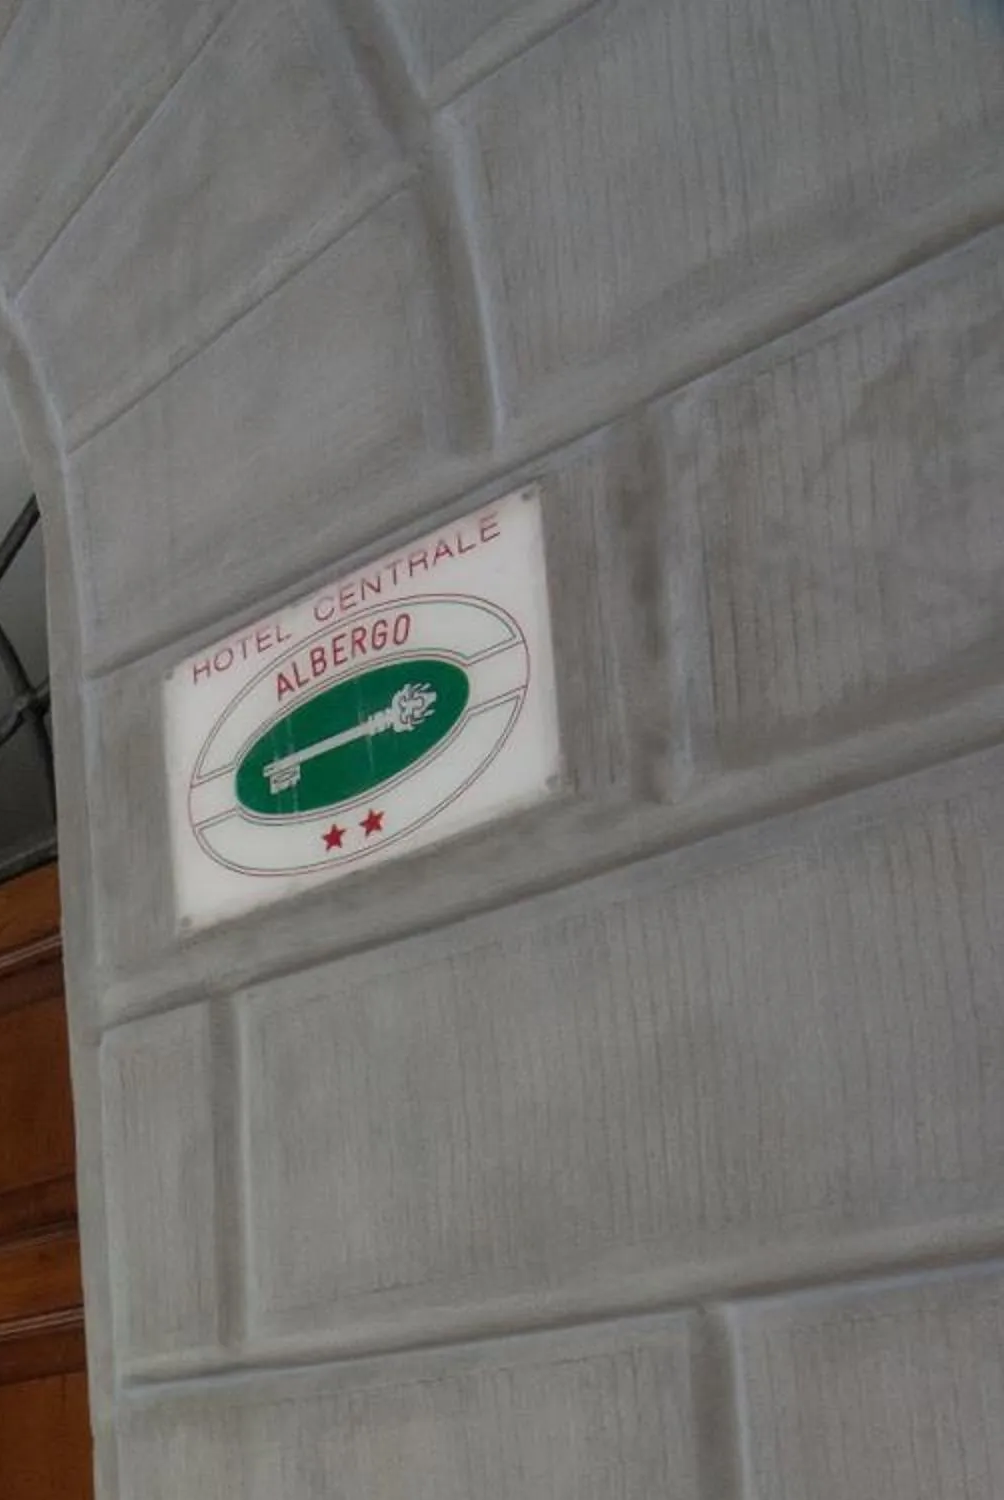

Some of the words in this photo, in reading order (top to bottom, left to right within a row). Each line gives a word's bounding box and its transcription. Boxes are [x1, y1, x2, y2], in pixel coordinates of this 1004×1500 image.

[192, 624, 292, 684] HOTEL
[312, 511, 502, 622] CENTRALE
[275, 612, 412, 702] ALBERGO
